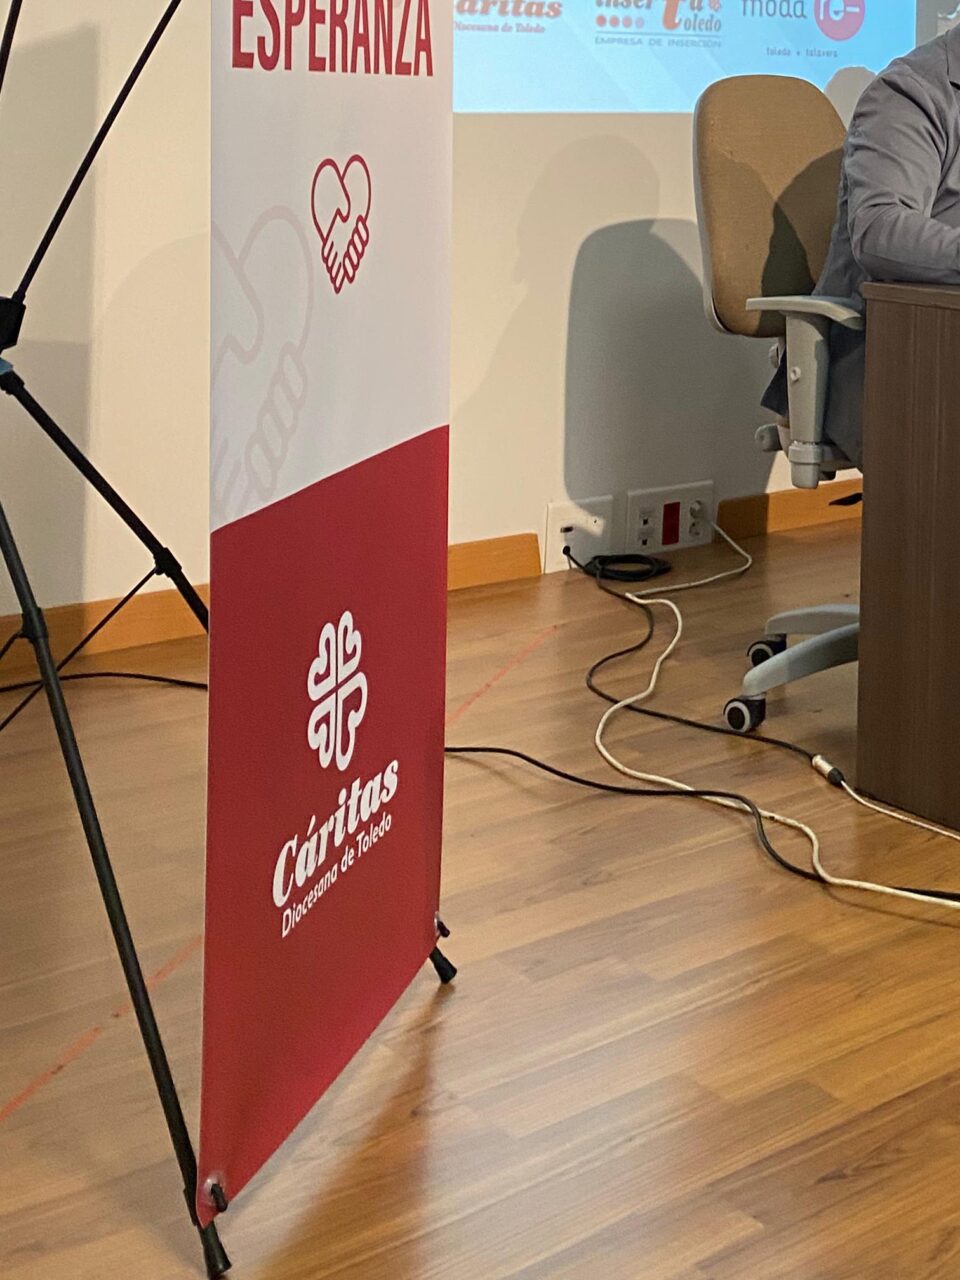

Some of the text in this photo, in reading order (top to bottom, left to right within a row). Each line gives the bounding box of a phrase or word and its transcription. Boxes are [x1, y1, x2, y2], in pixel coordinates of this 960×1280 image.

[272, 759, 399, 907] Cáritas
[282, 811, 392, 938] Diocesana de Toledo
